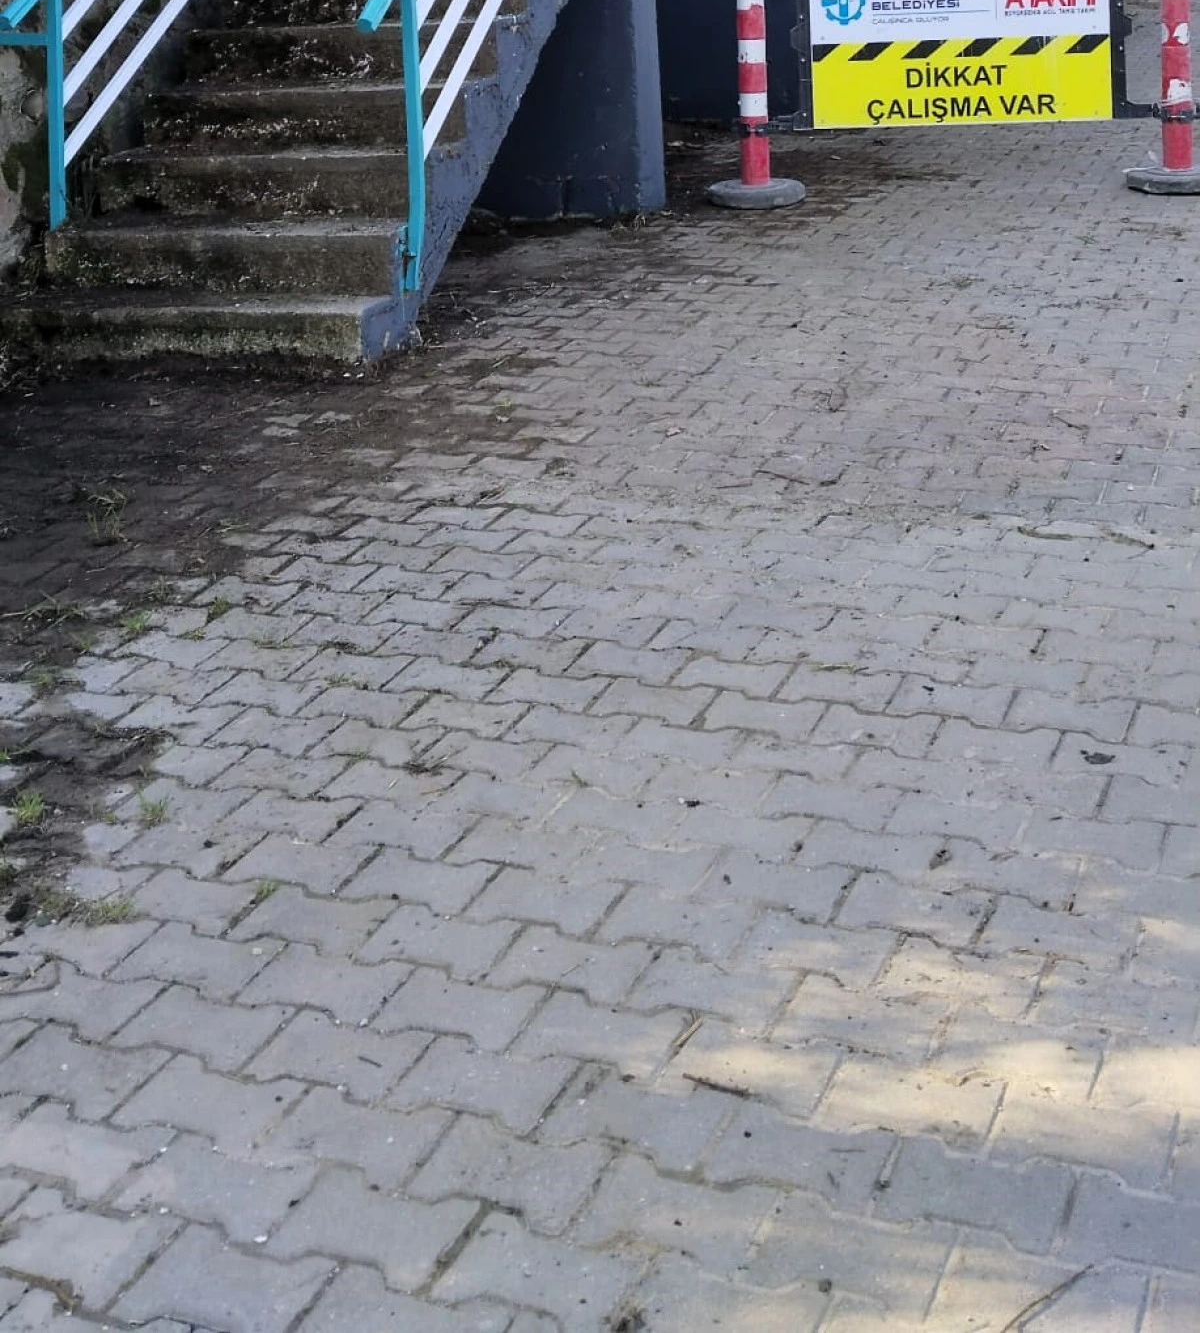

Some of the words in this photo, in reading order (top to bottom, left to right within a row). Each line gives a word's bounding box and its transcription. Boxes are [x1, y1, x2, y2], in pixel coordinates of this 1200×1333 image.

[871, 0, 960, 11] BELEDİYESİ
[906, 62, 1008, 88] DİKKAT
[867, 97, 993, 125] ÇALIŞMA
[1000, 94, 1056, 116] VAR
